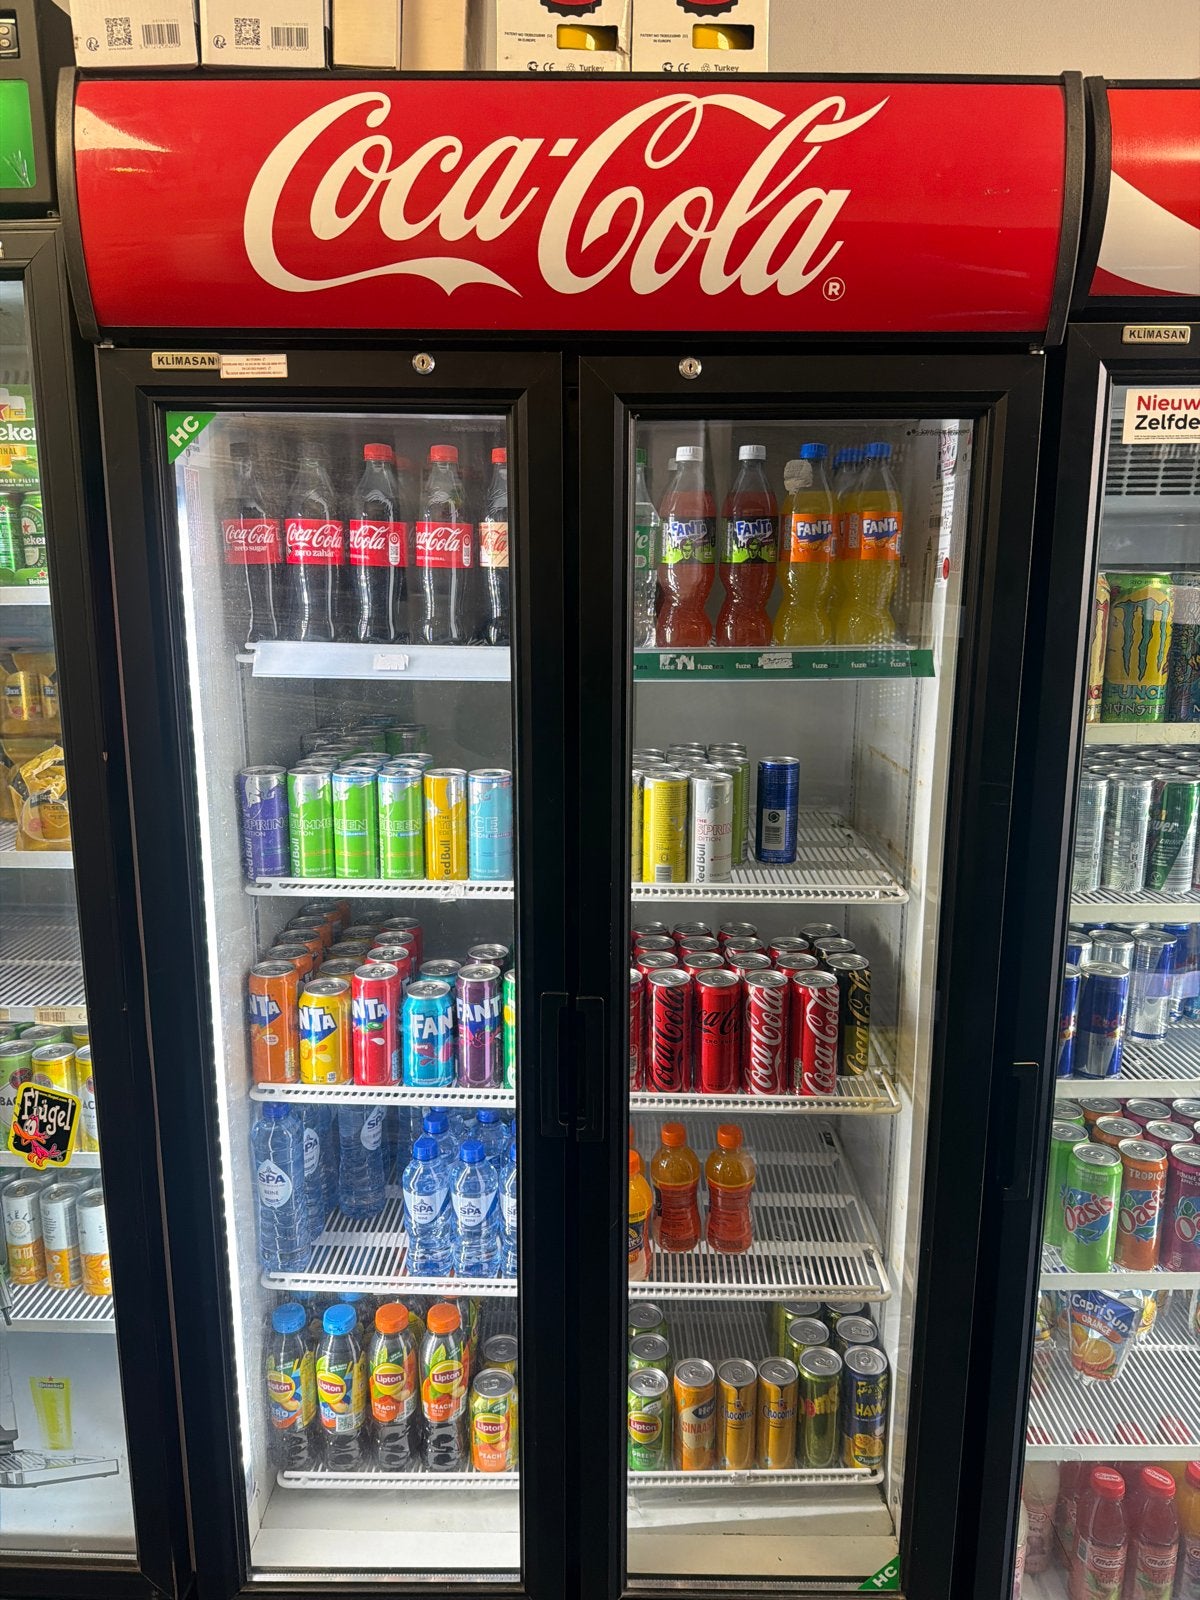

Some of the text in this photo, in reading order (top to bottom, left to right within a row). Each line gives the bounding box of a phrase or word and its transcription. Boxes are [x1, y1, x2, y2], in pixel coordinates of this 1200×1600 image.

[714, 64, 739, 72] Turkey
[243, 91, 890, 296] Coca-Cola
[168, 415, 200, 448] HC
[1134, 414, 1200, 430] Zelfde
[225, 524, 275, 544] Coca-Cola
[286, 522, 343, 548] Coca-Cola
[670, 519, 708, 537] FANTA
[735, 518, 773, 537] FANTA
[796, 520, 832, 537] FANTA
[862, 517, 898, 534] FANTA
[295, 549, 312, 557] zero
[292, 837, 300, 859] Bull
[440, 840, 451, 860] Bull
[696, 843, 706, 884] Red Bull
[299, 1006, 337, 1032] NTA
[352, 998, 387, 1020] NTA
[456, 995, 501, 1023] FANT
[411, 1006, 453, 1039] FAN
[748, 984, 783, 1095] Coca-Cola
[803, 983, 841, 1096] Coca-Cola
[21, 1087, 74, 1136] Flügel
[258, 1172, 286, 1185] SPA
[413, 1204, 434, 1213] SPA
[460, 1206, 482, 1215] SPA
[1064, 1192, 1114, 1233] Oasis
[1081, 1314, 1112, 1336] ORANGE
[376, 1374, 403, 1384] Lipton
[434, 1370, 461, 1383] Lipton
[374, 1402, 396, 1411] PEACH
[430, 1402, 454, 1410] PEACH
[477, 1421, 504, 1433] Lipton
[630, 1420, 657, 1432] Lipton
[872, 1565, 898, 1587] HC
